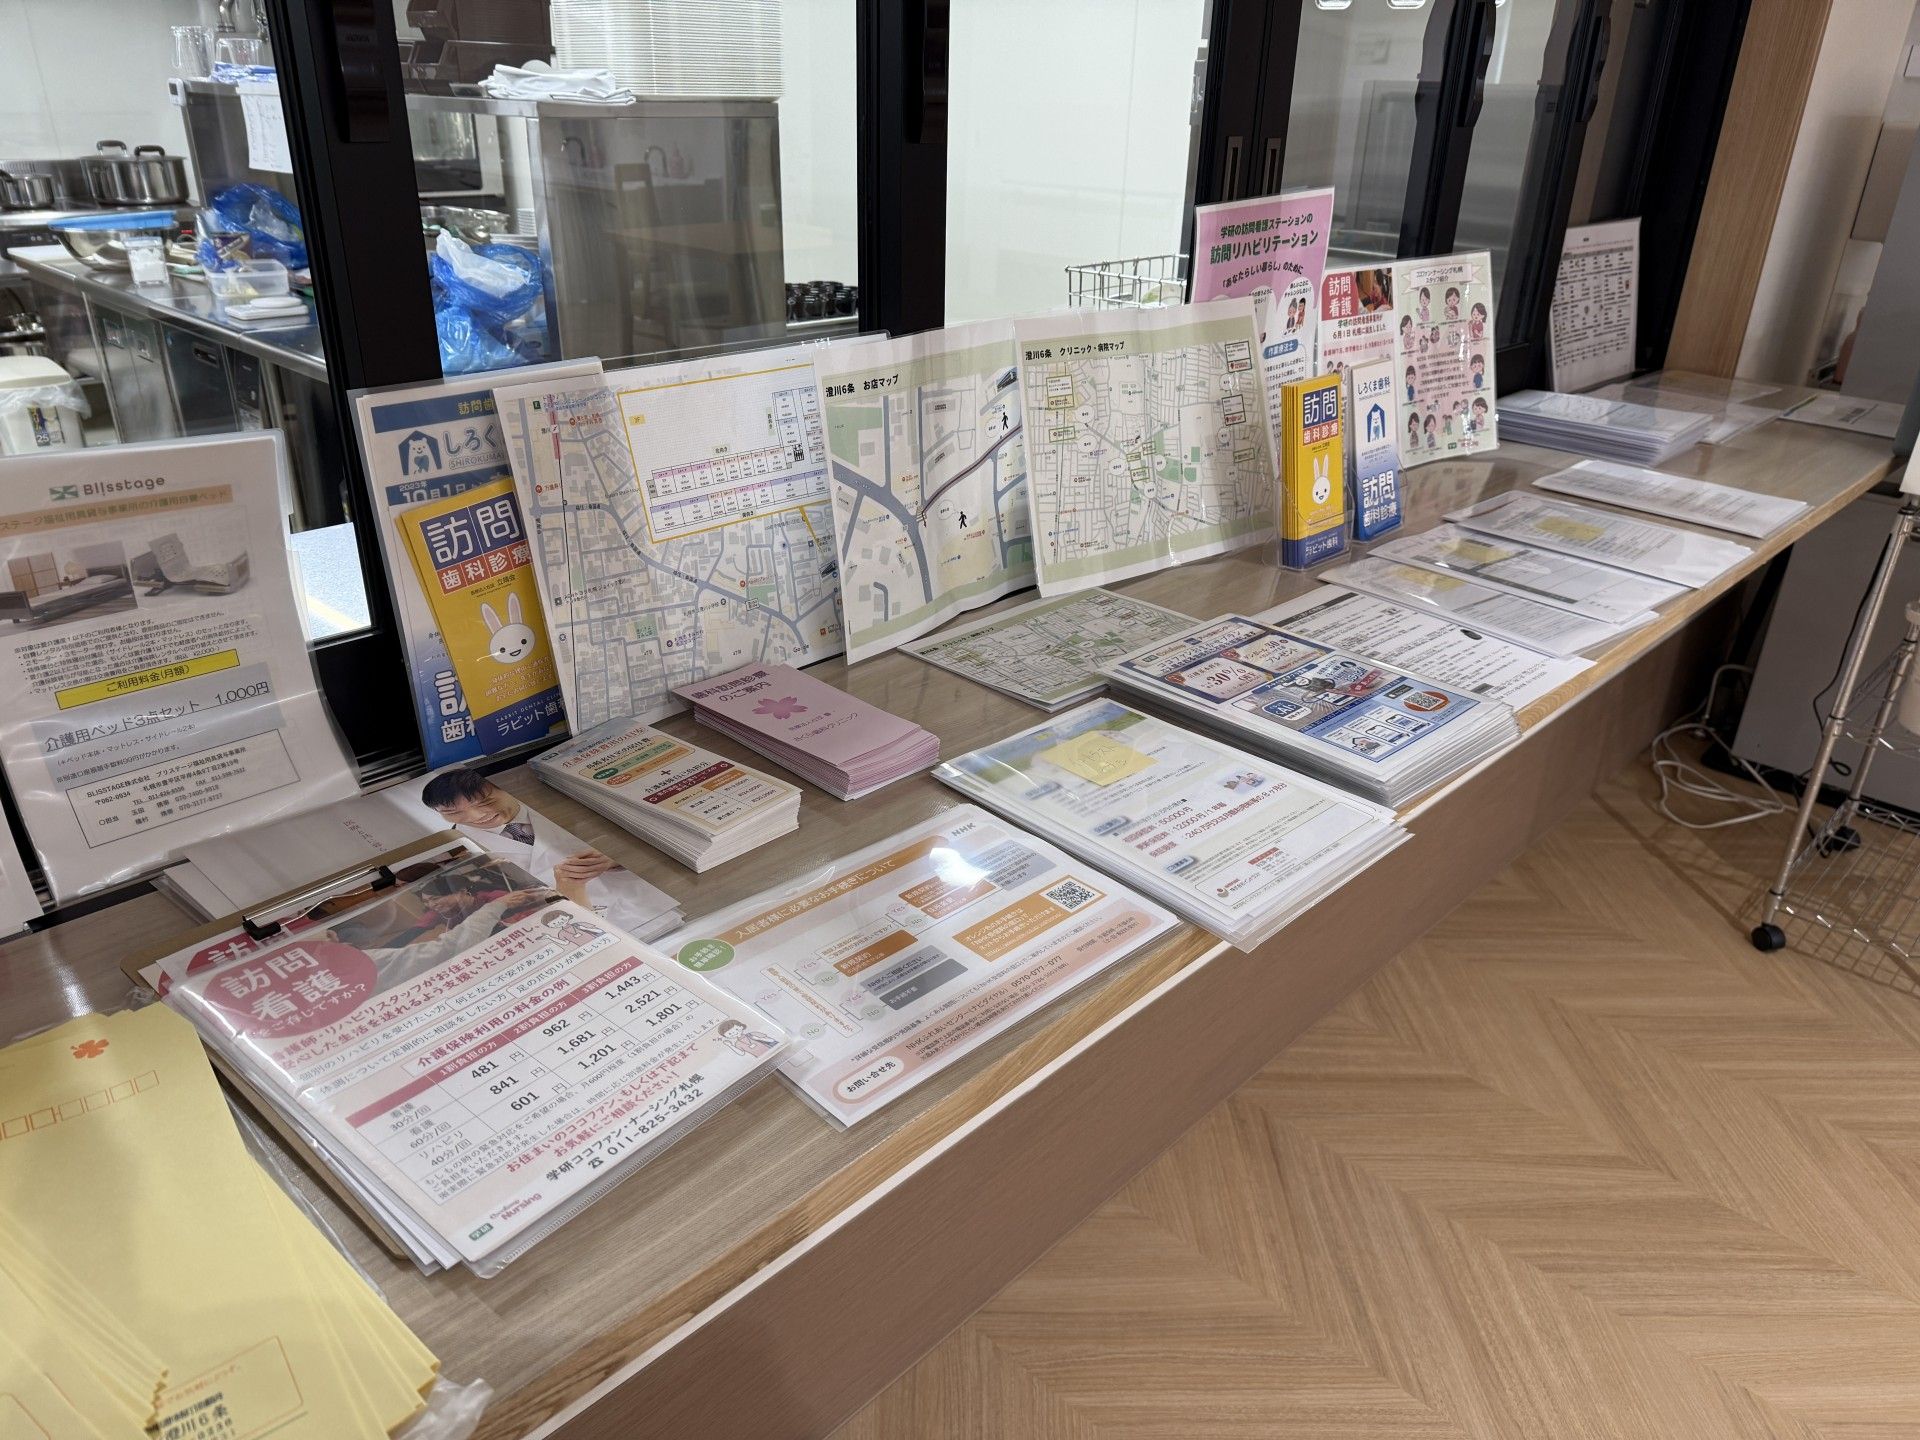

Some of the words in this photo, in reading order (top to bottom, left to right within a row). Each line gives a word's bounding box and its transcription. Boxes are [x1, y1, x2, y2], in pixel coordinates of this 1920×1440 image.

[1220, 213, 1313, 239] 学研の訪問看護ステーションの
[1210, 230, 1318, 265] 訪問リハビリテーション
[1329, 277, 1351, 297] 訪問
[1329, 297, 1352, 317] 看護
[1025, 346, 1052, 361] 澄川6条
[825, 383, 855, 398] 澄川6条
[863, 374, 899, 391] お店マップ
[1357, 375, 1391, 395] しろくま歯科
[1303, 389, 1338, 423] 訪問
[1303, 422, 1338, 443] 歯科診療
[84, 477, 165, 495] Blisstage
[1362, 470, 1396, 509] 訪問
[425, 498, 520, 564] 訪問
[1363, 501, 1398, 528] 歯科診療
[442, 544, 532, 590] 歯科診療
[1202, 665, 1248, 685] 30%
[44, 700, 200, 752] 介護用ベッド3点セット
[214, 681, 269, 706] 1,000円
[949, 821, 977, 837] NHK
[734, 855, 896, 942] 入居者様に必要なお手続きについて
[215, 946, 321, 1000] 訪問
[448, 947, 560, 1005] 何となく不安がある方
[510, 937, 616, 993] 足の爪切りが難しい方
[246, 968, 350, 1023] 看護
[866, 1008, 880, 1017] No
[409, 978, 575, 1068] 介護保険利用の料金の例
[467, 1058, 500, 1080] 481
[508, 1050, 526, 1062] 円
[539, 1017, 571, 1037] 962
[576, 1010, 594, 1021] 円
[602, 975, 644, 1000] 1,443
[640, 971, 656, 982] 円
[486, 1073, 520, 1096] 841
[528, 1065, 547, 1078] 円
[554, 1028, 599, 1056] 1,681
[599, 1024, 616, 1036] 円
[622, 988, 664, 1014] 2,521
[662, 984, 678, 995] 円
[806, 1027, 820, 1036] No
[417, 1129, 466, 1161] リハビリ
[507, 1089, 540, 1112] 601
[550, 1081, 568, 1094] 円
[575, 1042, 618, 1070] 1,201
[619, 1038, 636, 1051] 円
[642, 1001, 685, 1028] 1,801
[683, 998, 700, 1009] 円
[844, 1060, 896, 1093] お問い合せ先
[501, 1043, 702, 1173] お住まいのココファン、もしくは下記まで
[549, 1069, 682, 1157] お気軽にご相談ください！
[604, 1087, 704, 1156] 011-825-3432
[543, 1072, 705, 1182] 学研ココファン・ナーシング札幌
[498, 1190, 543, 1222] Nursing
